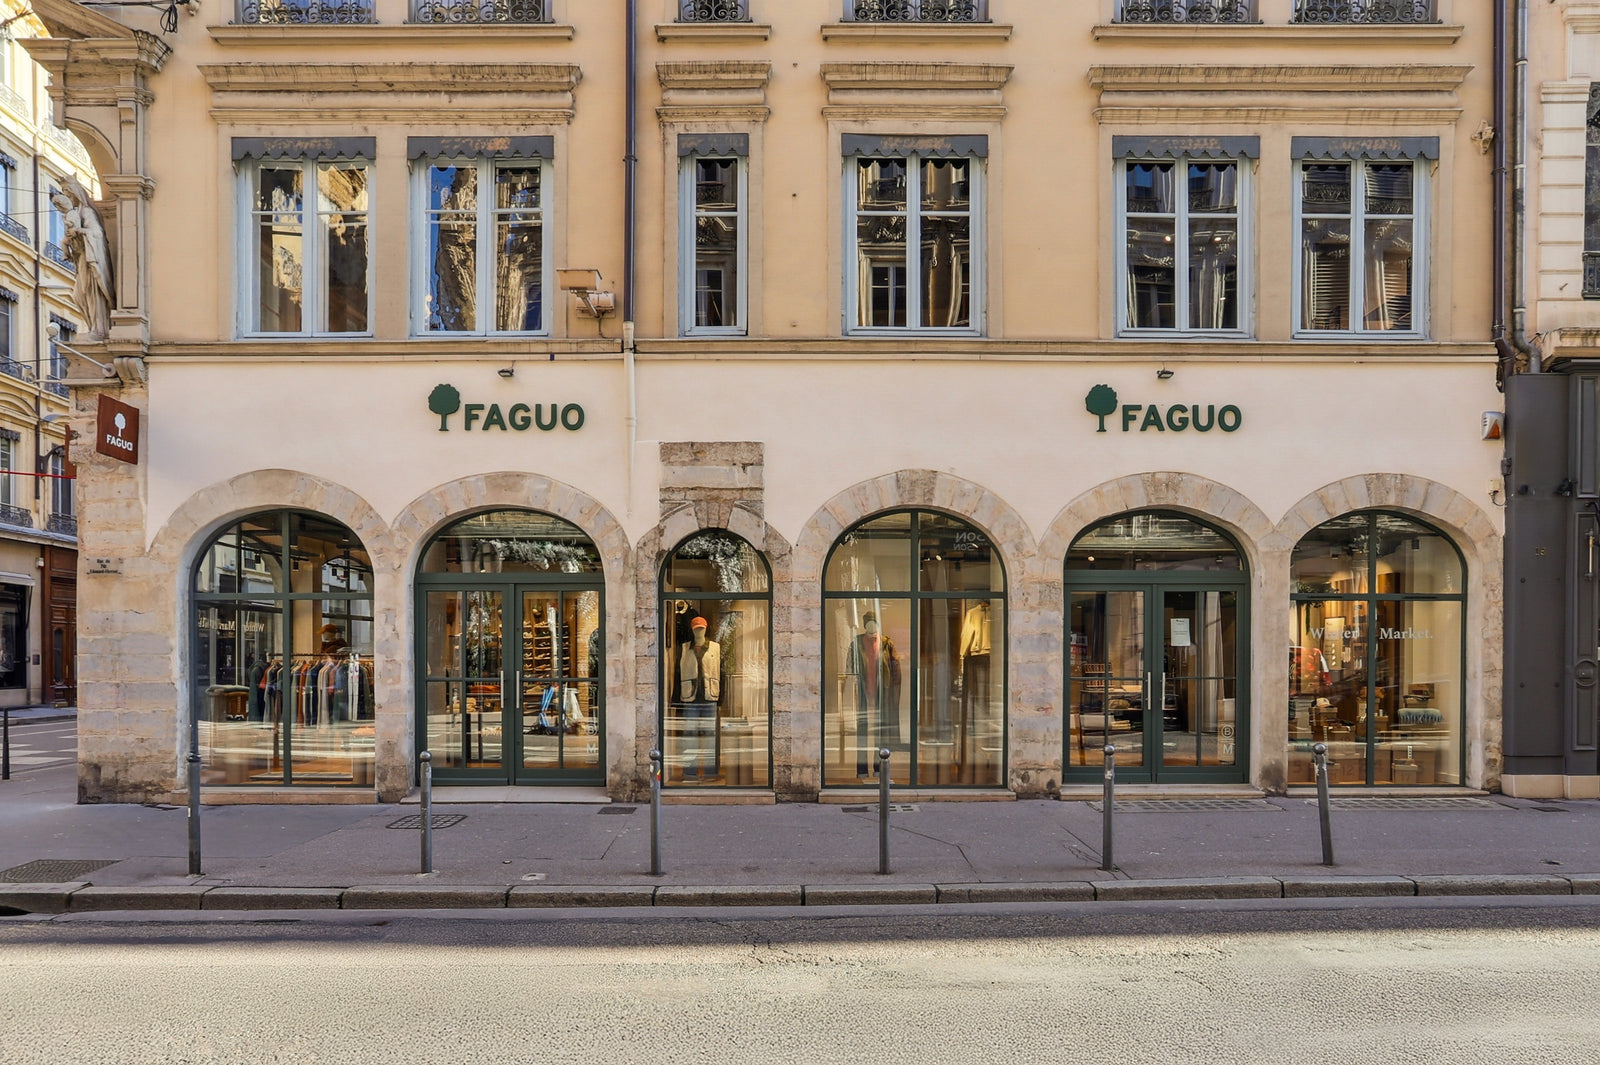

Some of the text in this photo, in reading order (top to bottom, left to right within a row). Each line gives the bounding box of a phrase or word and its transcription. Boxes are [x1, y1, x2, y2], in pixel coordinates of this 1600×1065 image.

[464, 403, 585, 432] FAGUO
[1121, 403, 1242, 433] FAGUO
[106, 434, 133, 451] FAGUO
[1379, 627, 1433, 640] Market.
[1223, 744, 1233, 754] M
